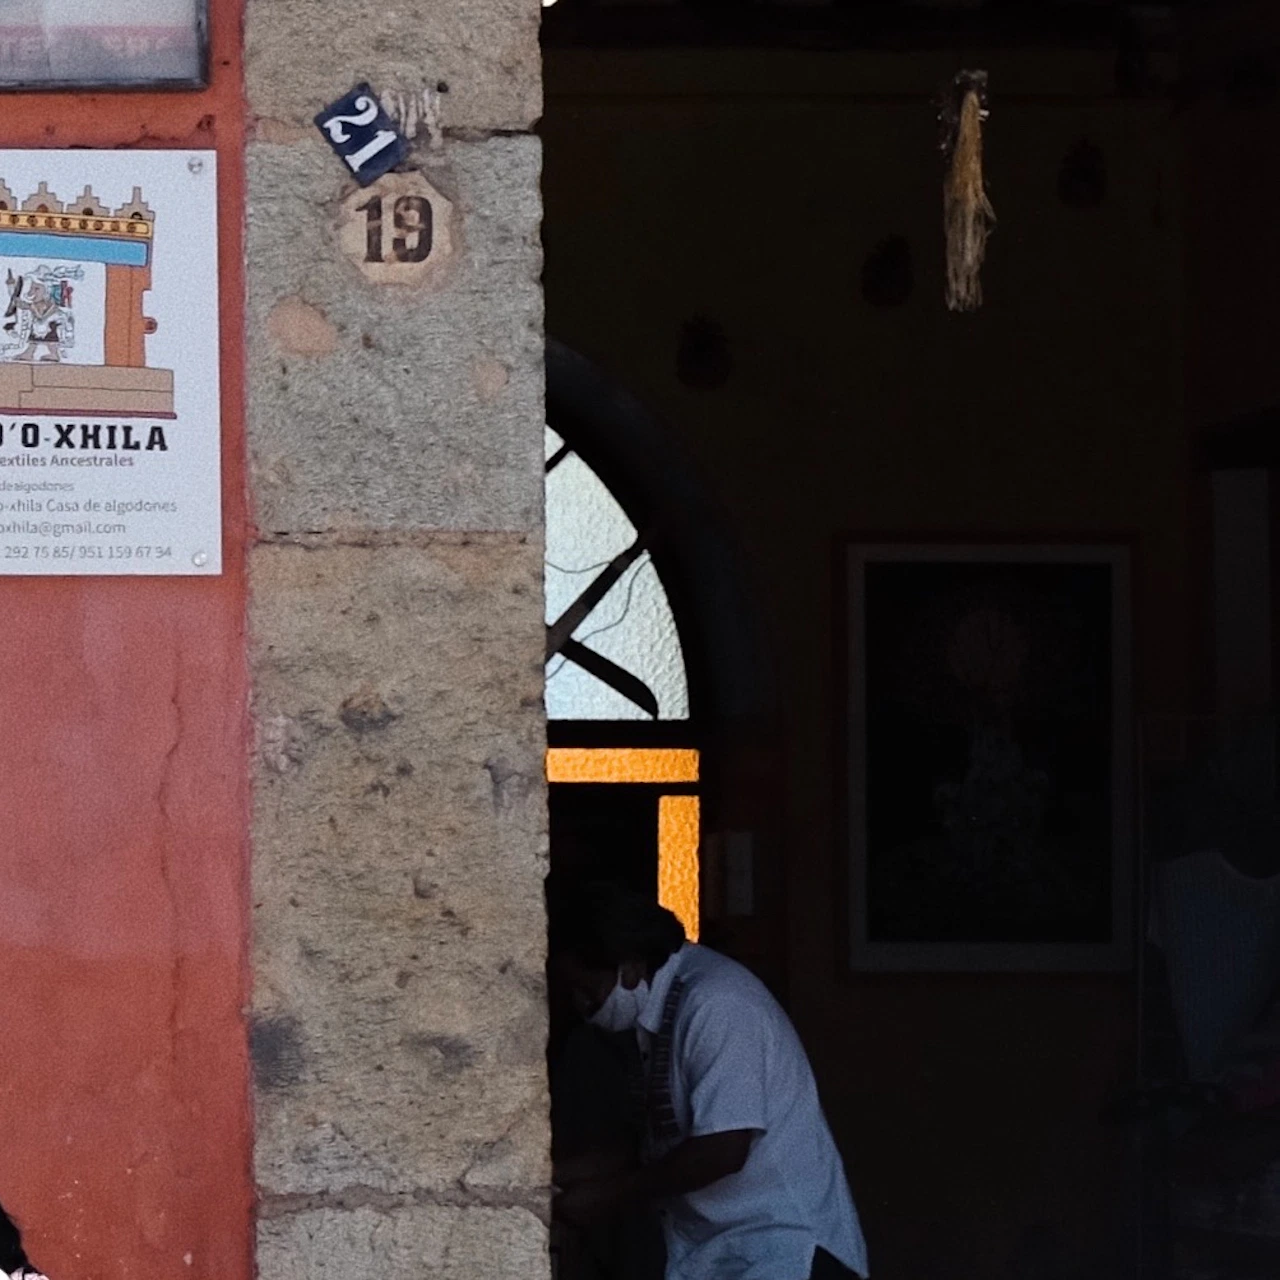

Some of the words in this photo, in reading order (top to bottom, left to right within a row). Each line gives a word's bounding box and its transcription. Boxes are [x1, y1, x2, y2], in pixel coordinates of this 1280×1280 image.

[323, 96, 397, 173] 21
[355, 195, 433, 263] 19
[49, 454, 134, 467] Ancestrales
[46, 499, 80, 512] Casa
[83, 499, 101, 512] de
[104, 499, 177, 516] algodones
[4, 546, 29, 559] 292
[79, 546, 104, 559] 951
[108, 546, 133, 559] 159
[135, 546, 151, 559] 67
